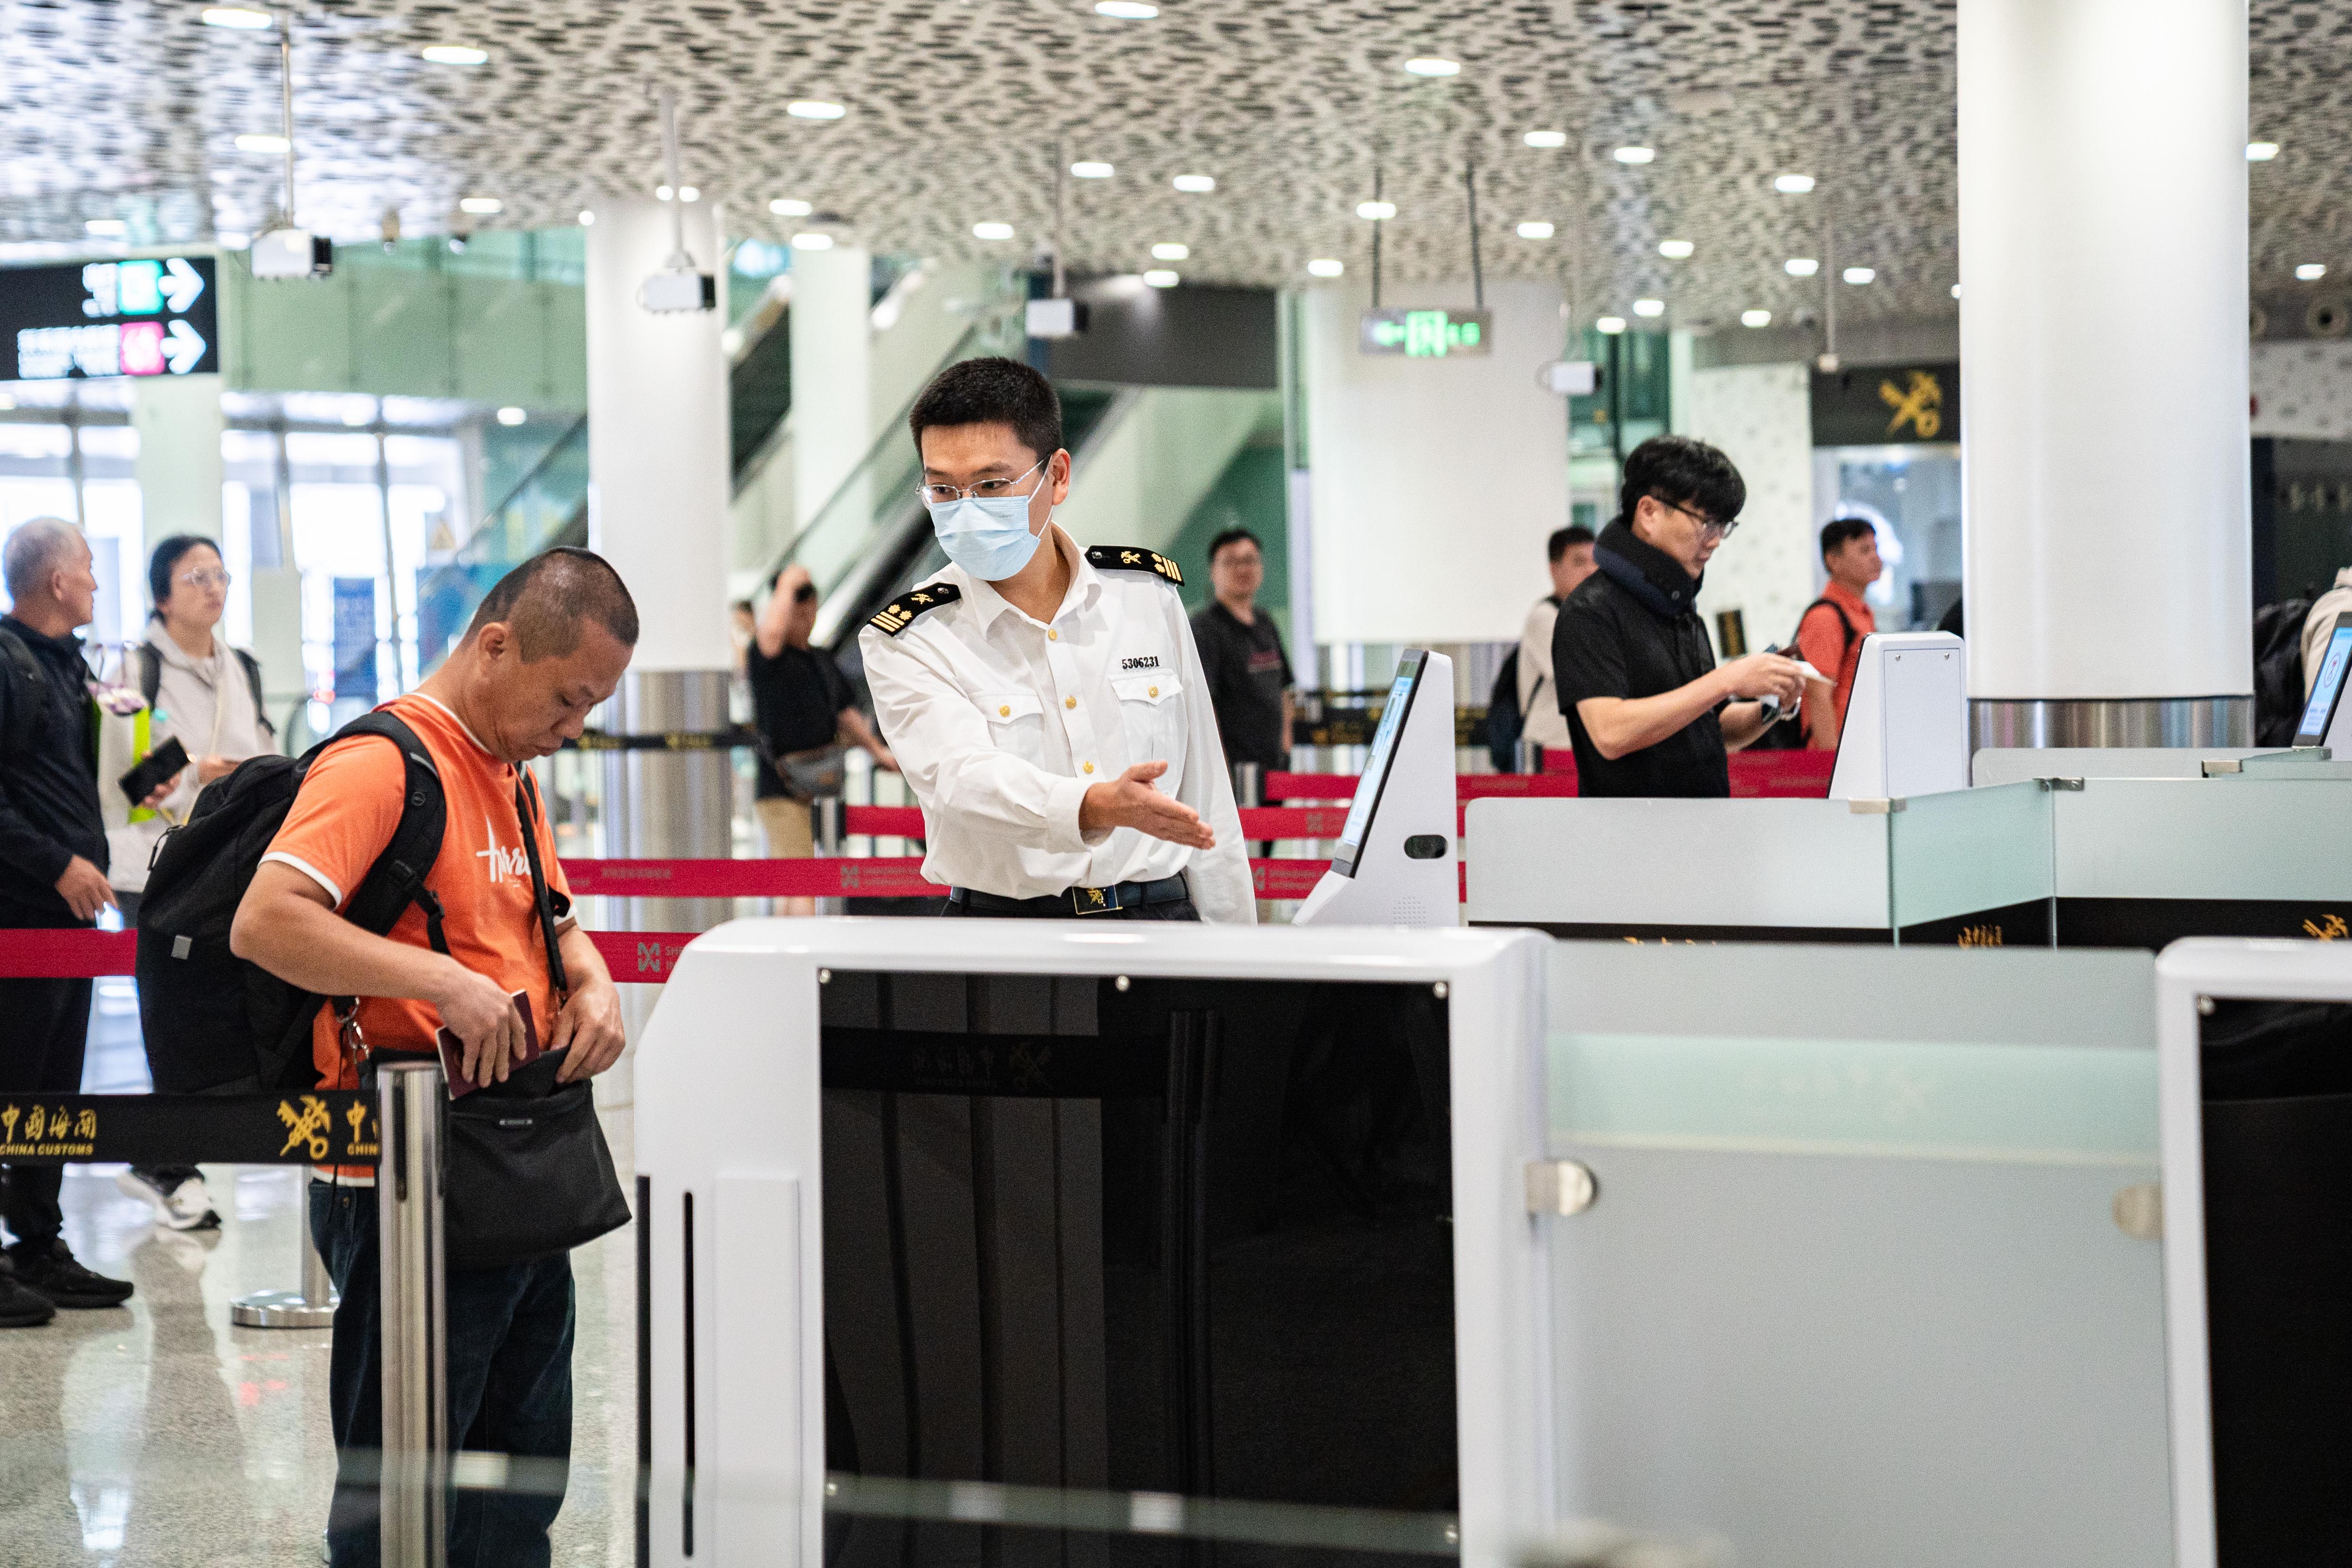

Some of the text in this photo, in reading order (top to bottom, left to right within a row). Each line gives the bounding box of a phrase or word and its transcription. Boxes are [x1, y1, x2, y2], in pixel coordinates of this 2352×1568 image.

[1122, 656, 1160, 669] 5306231
[0, 1142, 94, 1156] CHINA CUSTOMS
